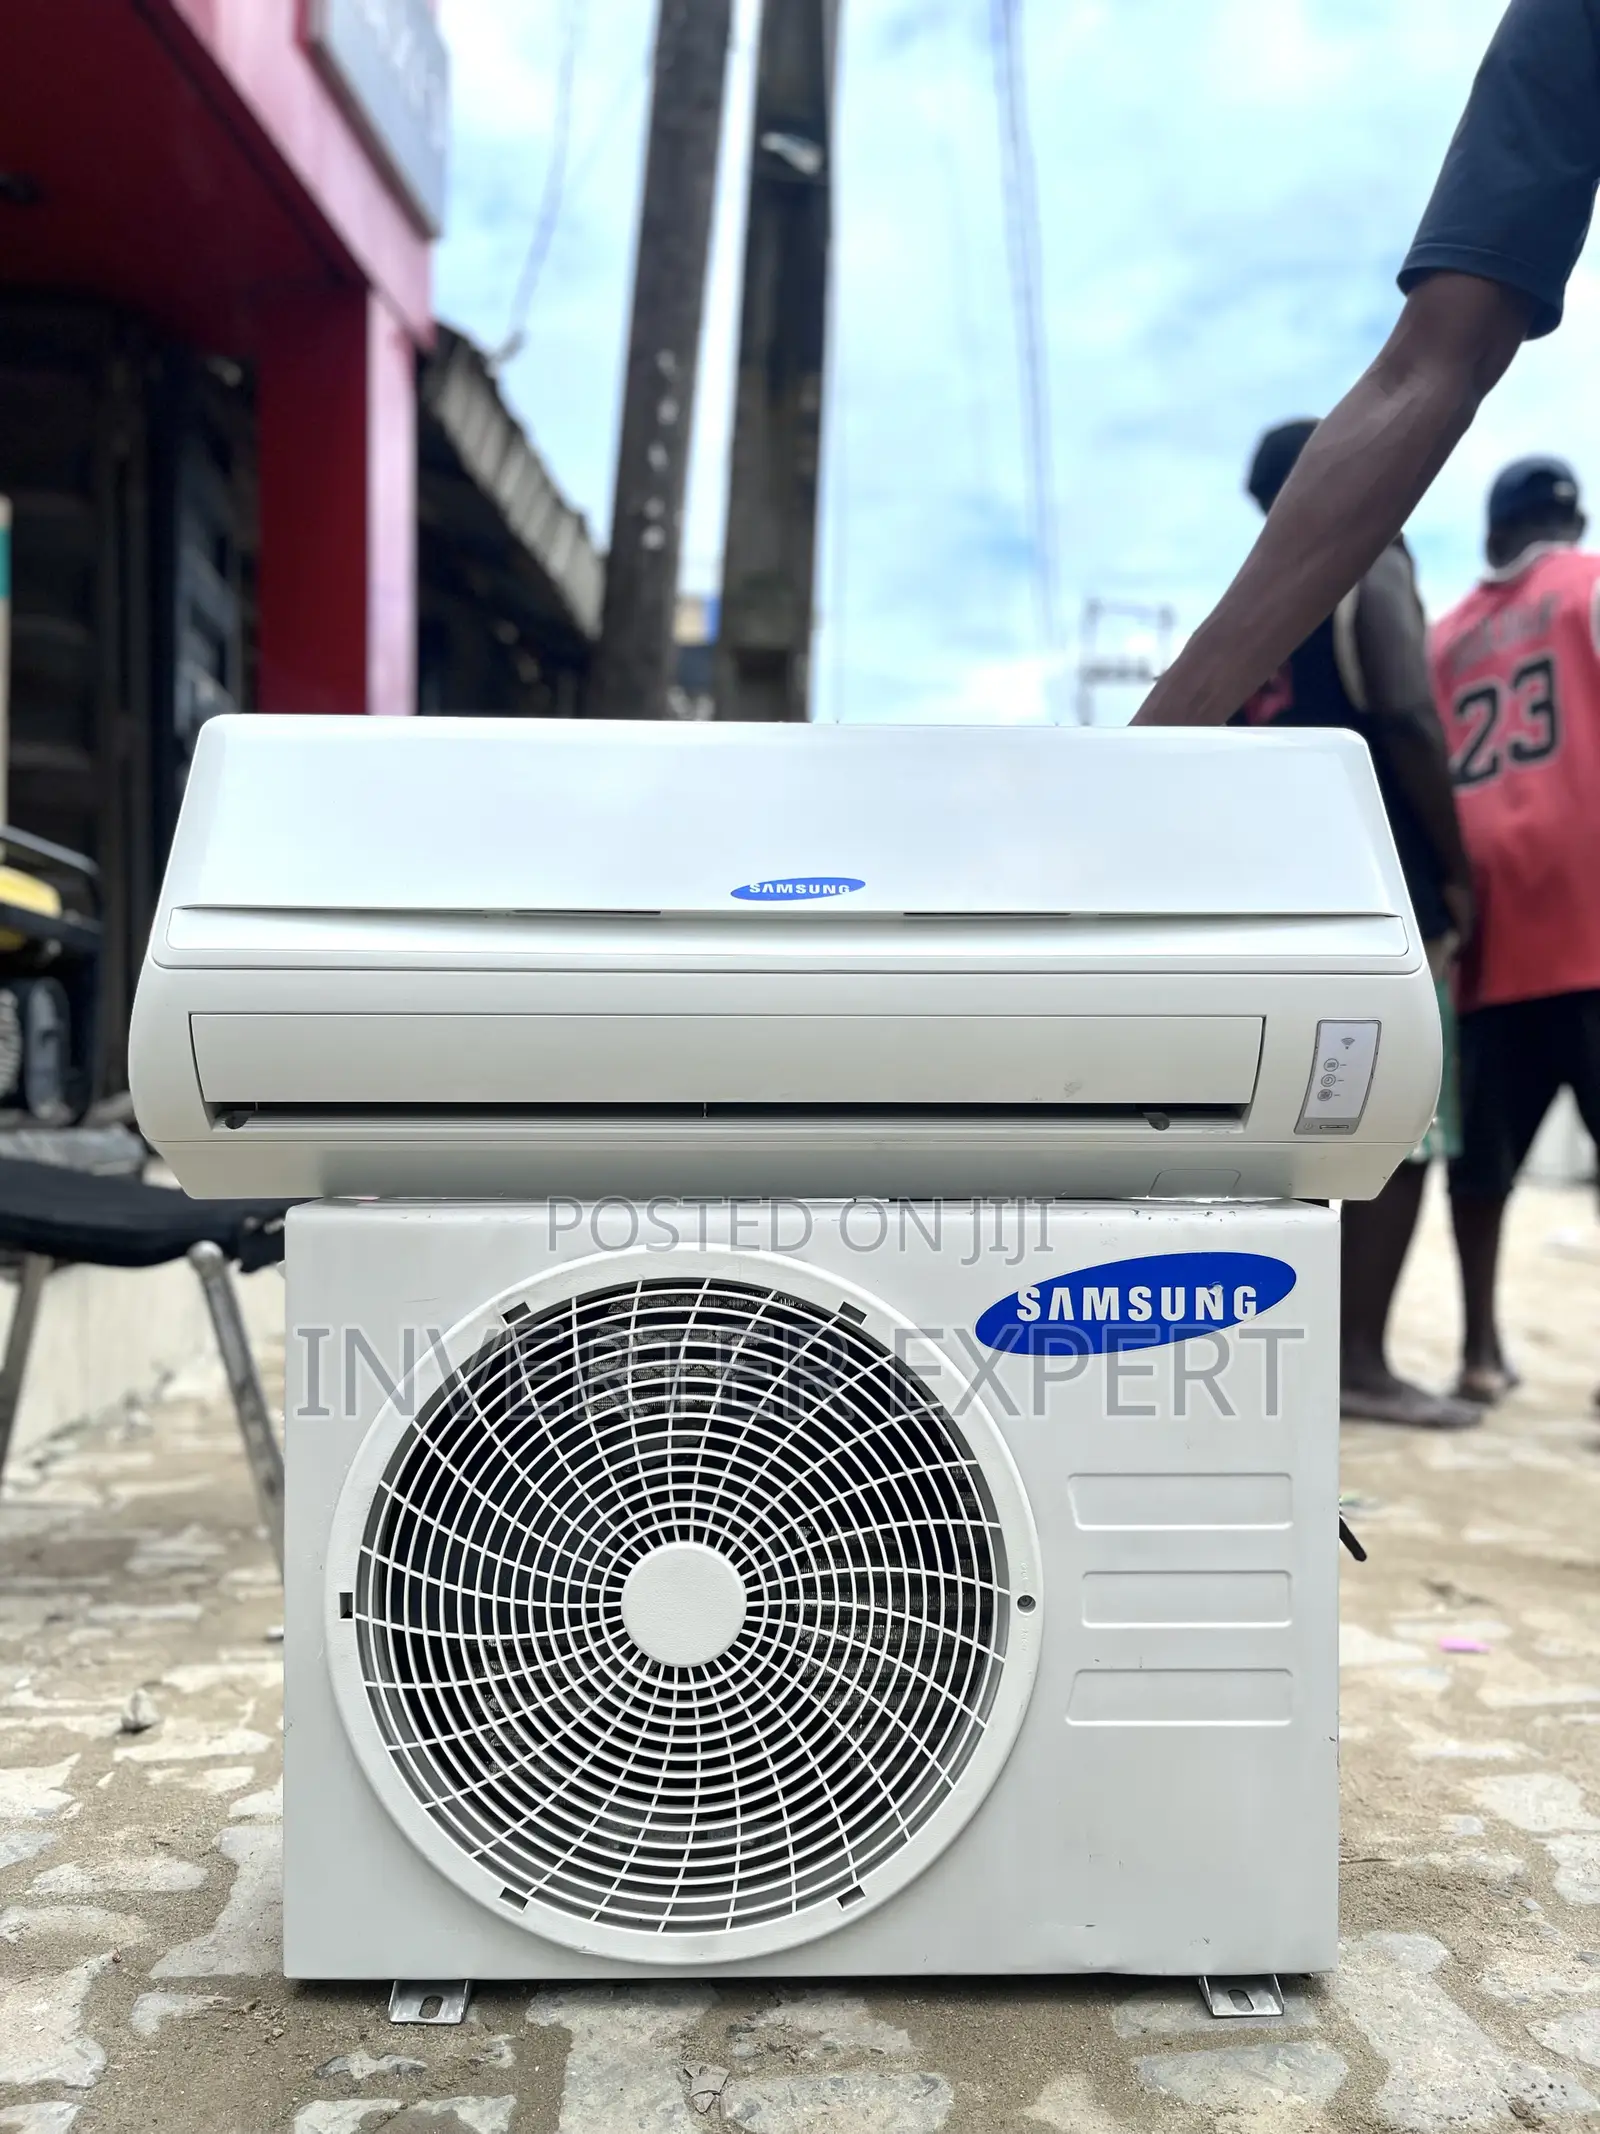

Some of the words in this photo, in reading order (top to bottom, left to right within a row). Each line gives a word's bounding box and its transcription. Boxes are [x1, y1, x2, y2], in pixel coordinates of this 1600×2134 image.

[1450, 655, 1559, 788] 23
[749, 883, 851, 894] SAMSUNG
[1016, 1285, 1257, 1322] SAMSUNG
